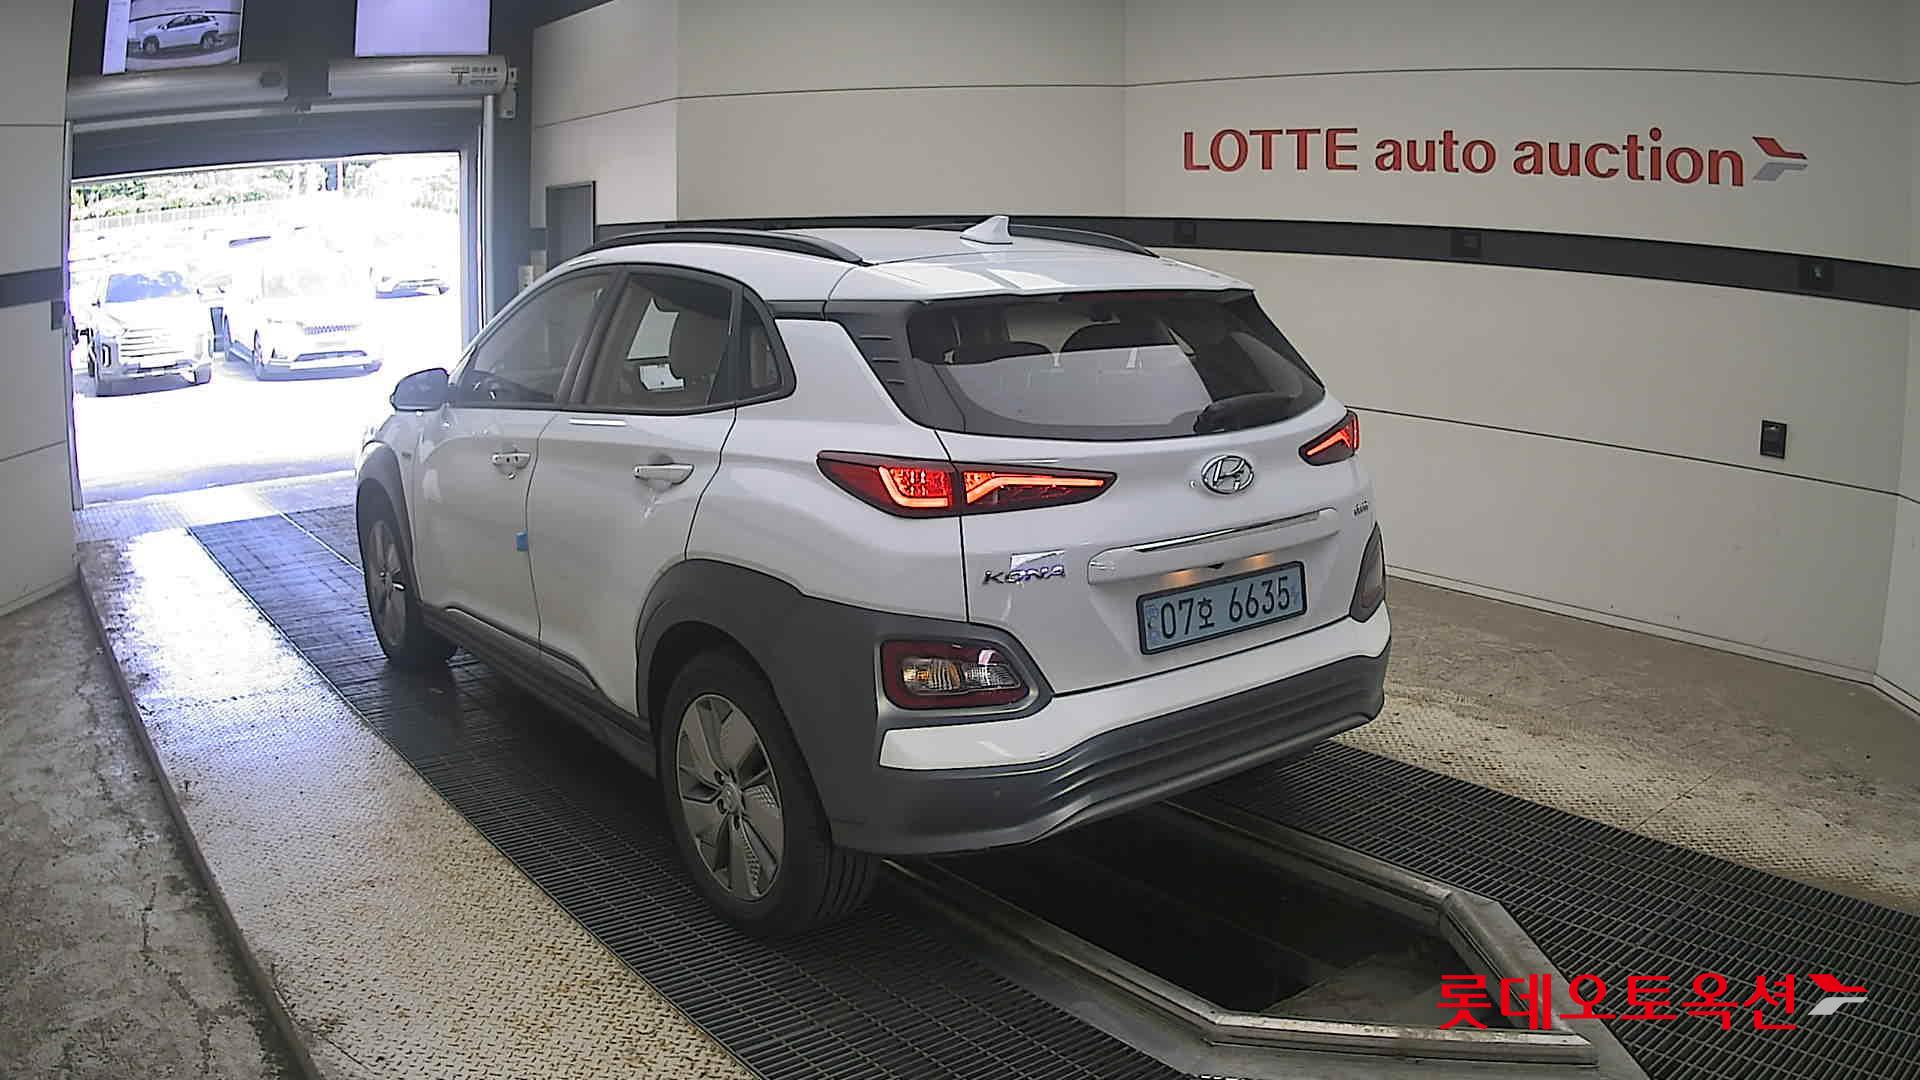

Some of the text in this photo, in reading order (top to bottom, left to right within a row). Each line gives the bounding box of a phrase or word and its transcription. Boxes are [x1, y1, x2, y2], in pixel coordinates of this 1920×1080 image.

[1184, 127, 1744, 187] LOTTE auto auction
[982, 565, 1066, 585] KONA
[1161, 576, 1290, 639] 07호 6635
